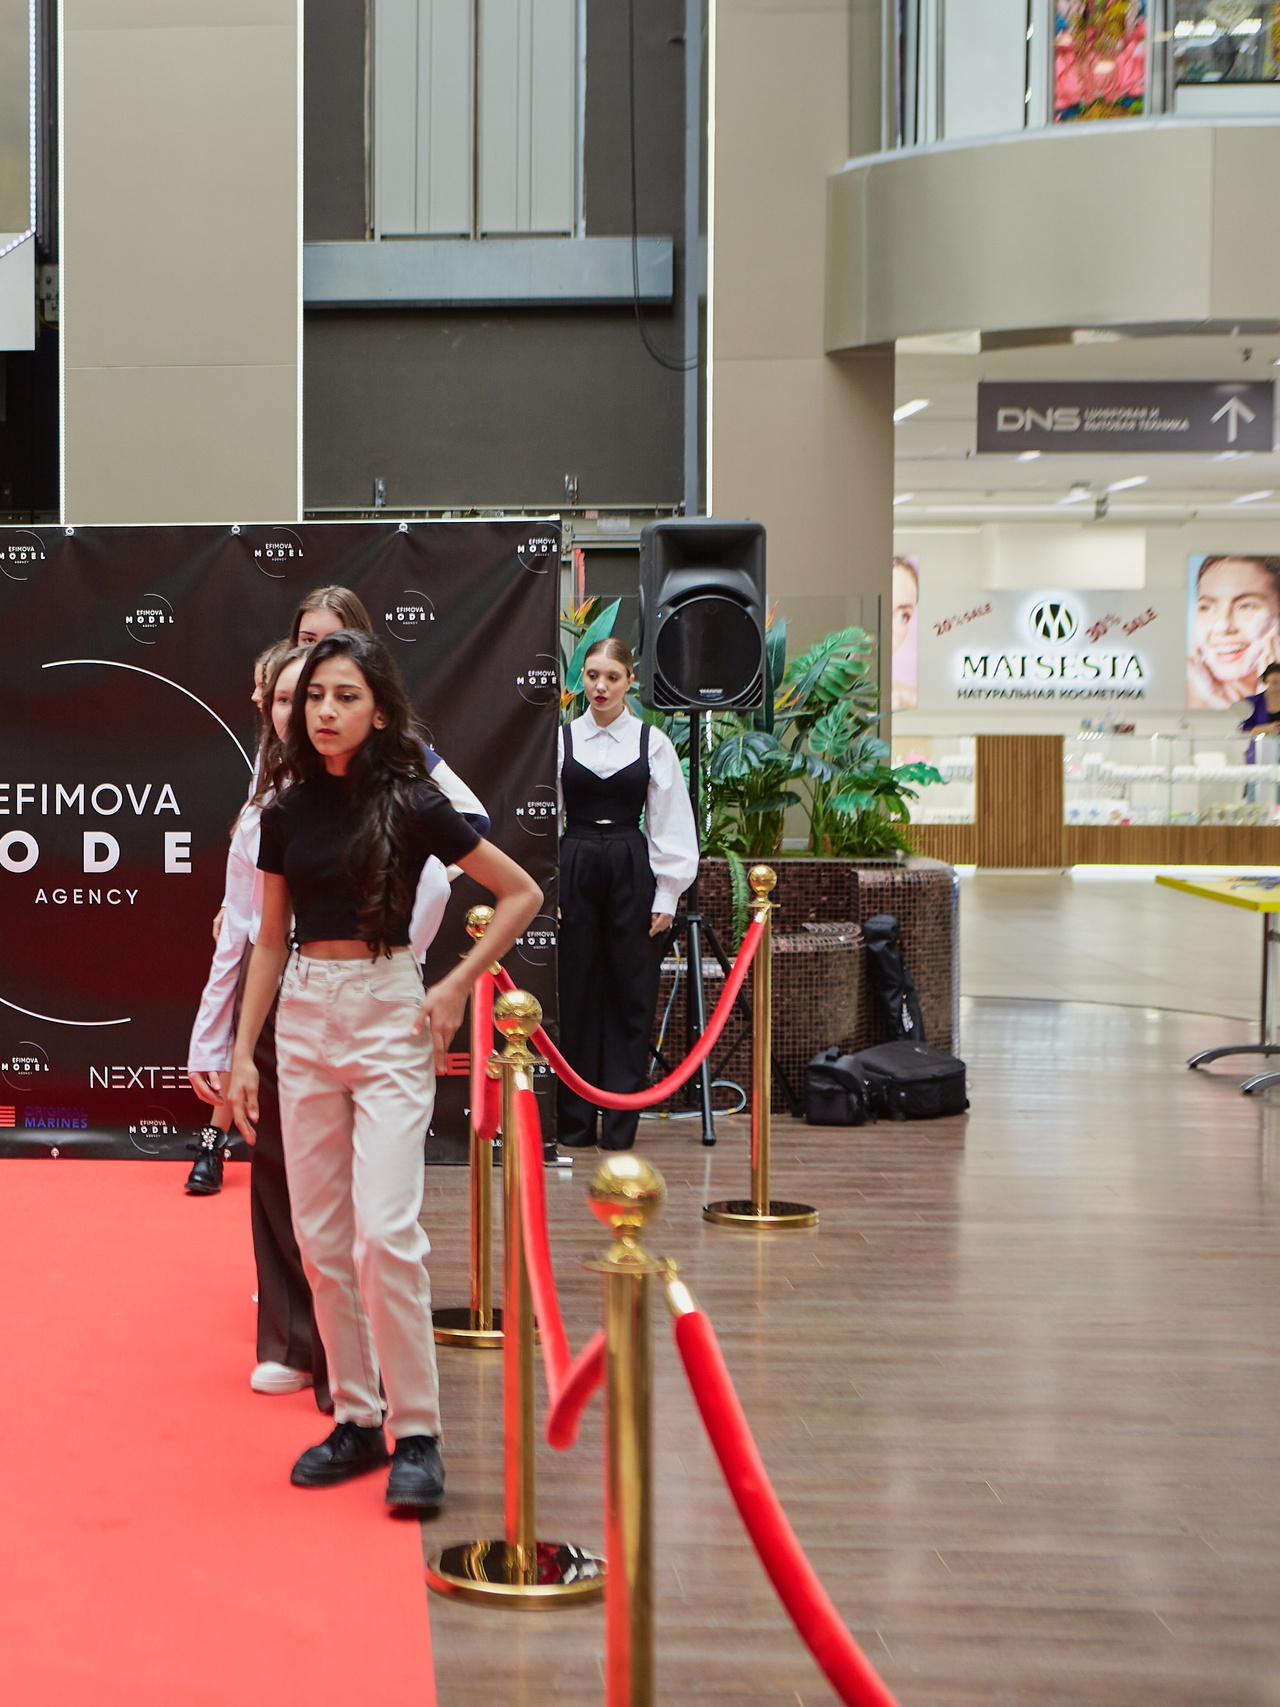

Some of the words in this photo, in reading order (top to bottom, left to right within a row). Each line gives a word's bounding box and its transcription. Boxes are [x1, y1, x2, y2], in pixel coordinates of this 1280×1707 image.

[997, 406, 1081, 432] DNS
[255, 549, 303, 557] MODEL
[962, 655, 1144, 680] MATSESTA
[957, 688, 1055, 700] НАТУРАЛЬНАЯ
[1060, 688, 1145, 700] КОСМЕТИКА
[35, 889, 138, 905] AGENCY
[2, 1063, 49, 1071] MODEL
[24, 1107, 88, 1117] ORIGINAL
[24, 1118, 88, 1129] MARINES
